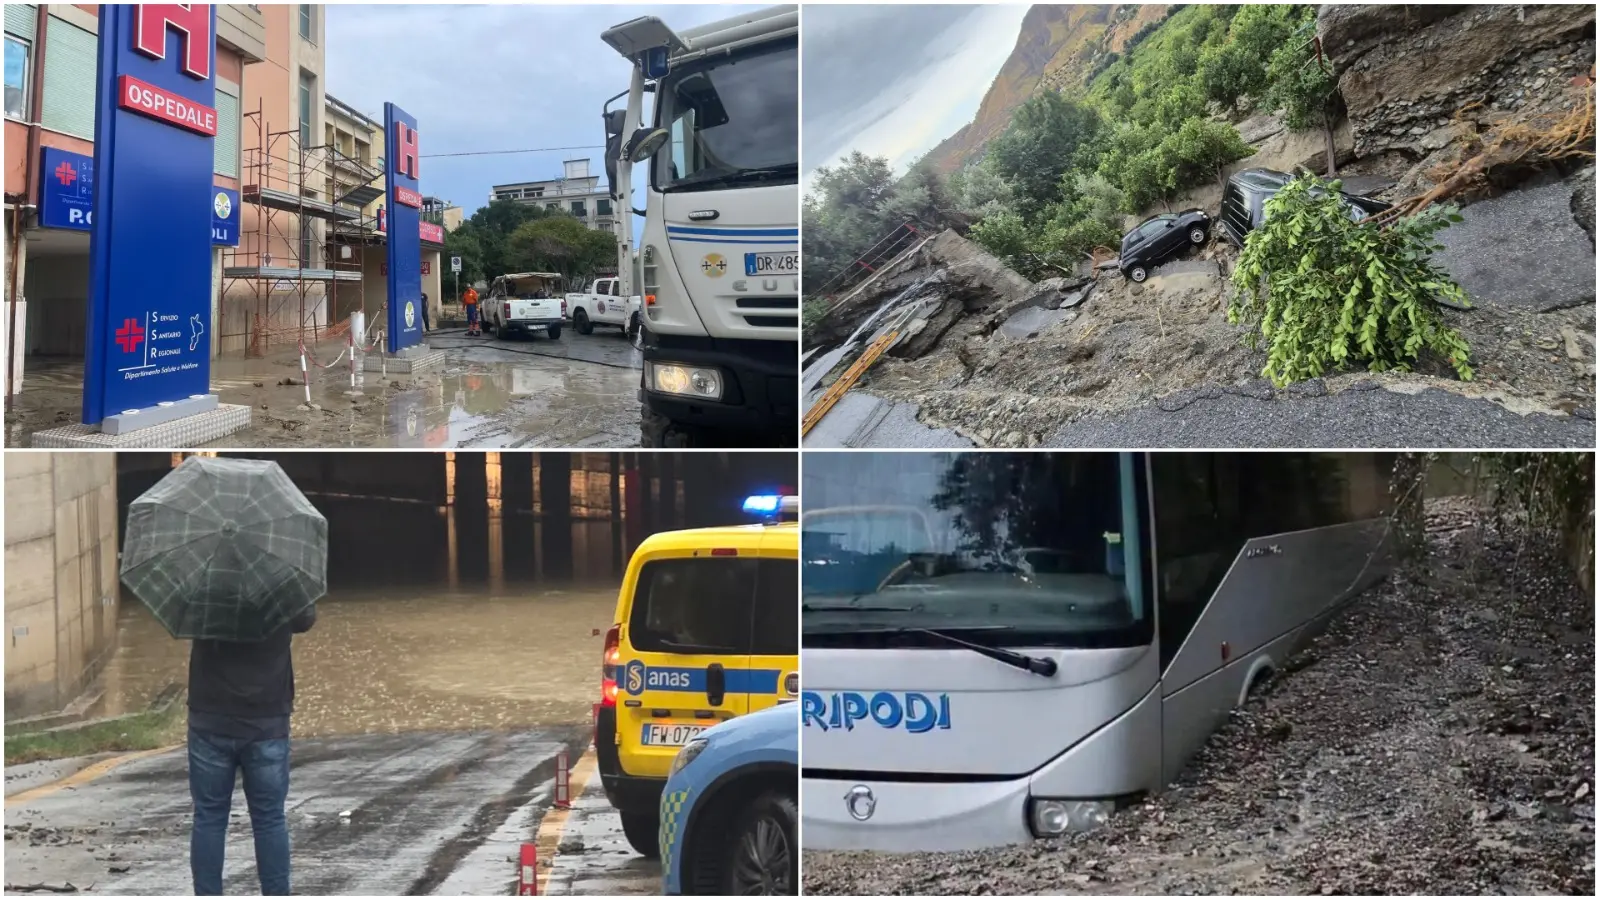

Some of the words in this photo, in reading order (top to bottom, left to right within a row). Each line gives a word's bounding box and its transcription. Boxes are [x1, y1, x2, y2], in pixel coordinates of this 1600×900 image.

[133, 4, 211, 80] H
[128, 84, 214, 130] OSPEDALE
[396, 120, 419, 180] H
[757, 256, 773, 271] DR
[124, 369, 161, 380] Dipartimento
[161, 365, 177, 374] Salute
[648, 671, 690, 687] anas
[802, 691, 951, 733] RIPODI
[651, 726, 668, 743] FW
[673, 726, 707, 743] 072
